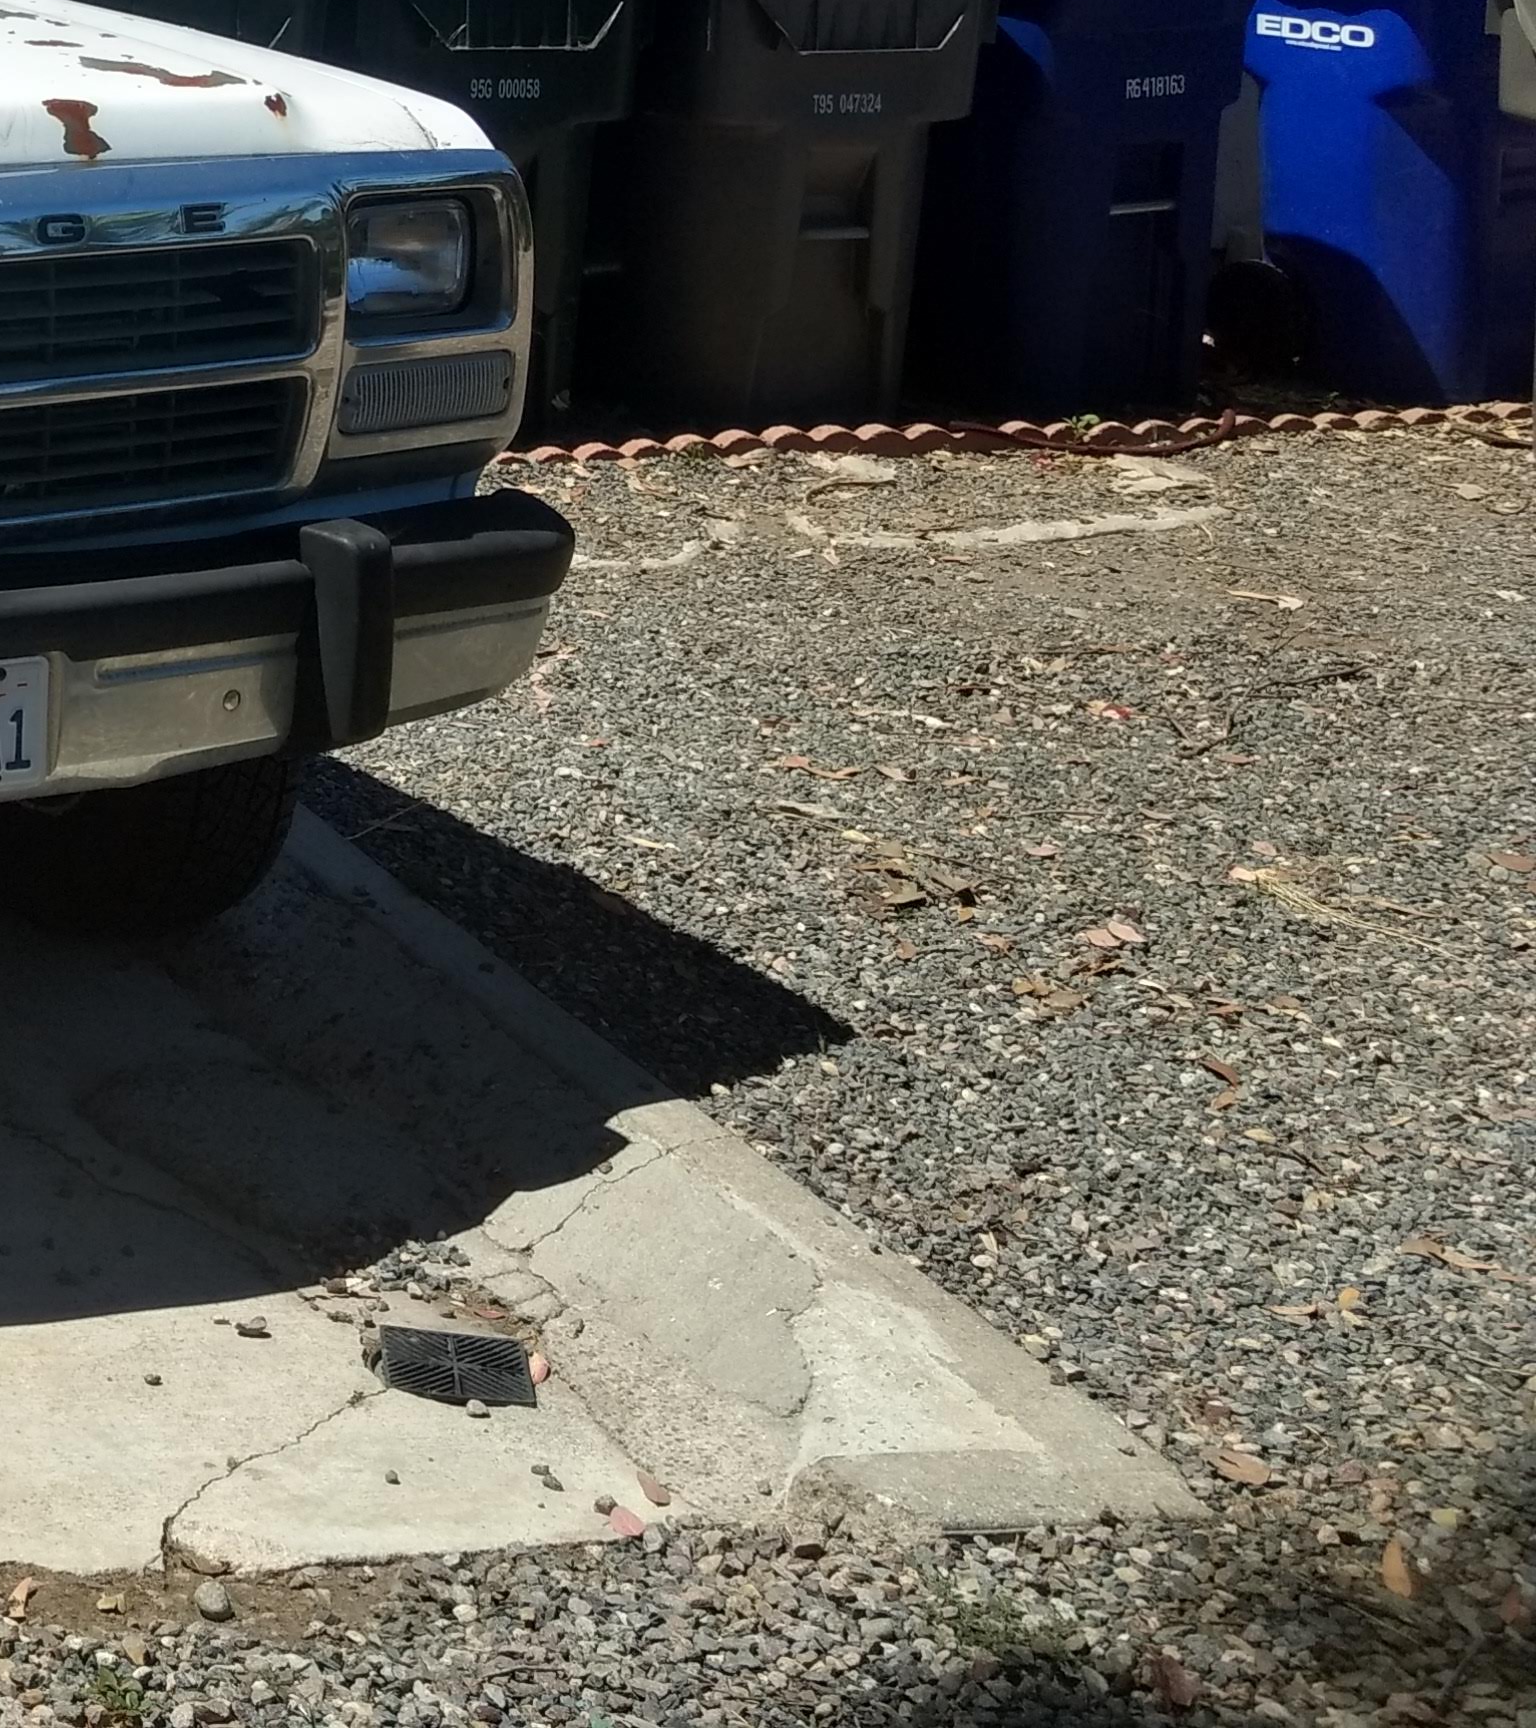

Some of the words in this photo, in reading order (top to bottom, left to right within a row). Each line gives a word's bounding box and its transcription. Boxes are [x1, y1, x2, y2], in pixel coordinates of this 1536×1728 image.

[1256, 13, 1375, 48] EDCO
[470, 78, 493, 99] 95G
[498, 78, 541, 99] 000058
[812, 94, 834, 114] T95
[839, 93, 882, 113] 047324
